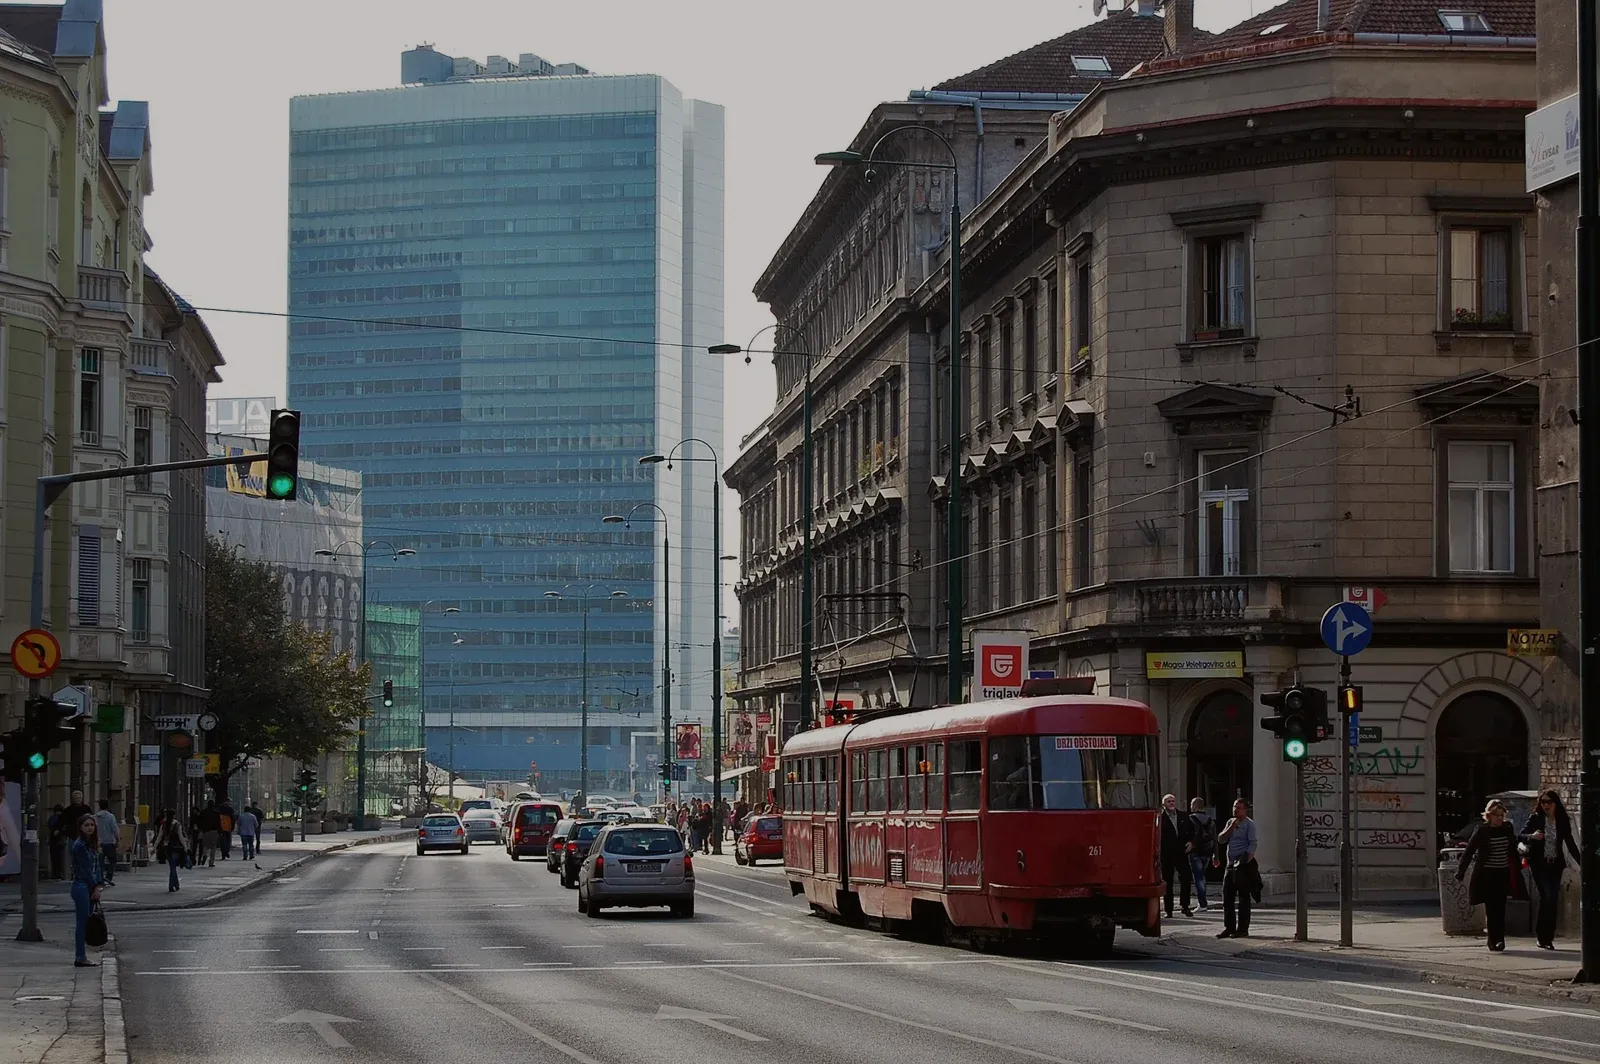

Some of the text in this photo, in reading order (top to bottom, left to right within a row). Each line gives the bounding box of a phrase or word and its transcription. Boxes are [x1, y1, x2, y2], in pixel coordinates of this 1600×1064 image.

[1510, 633, 1557, 645] NOTAR
[983, 687, 1020, 700] triglav
[1089, 846, 1102, 856] 261
